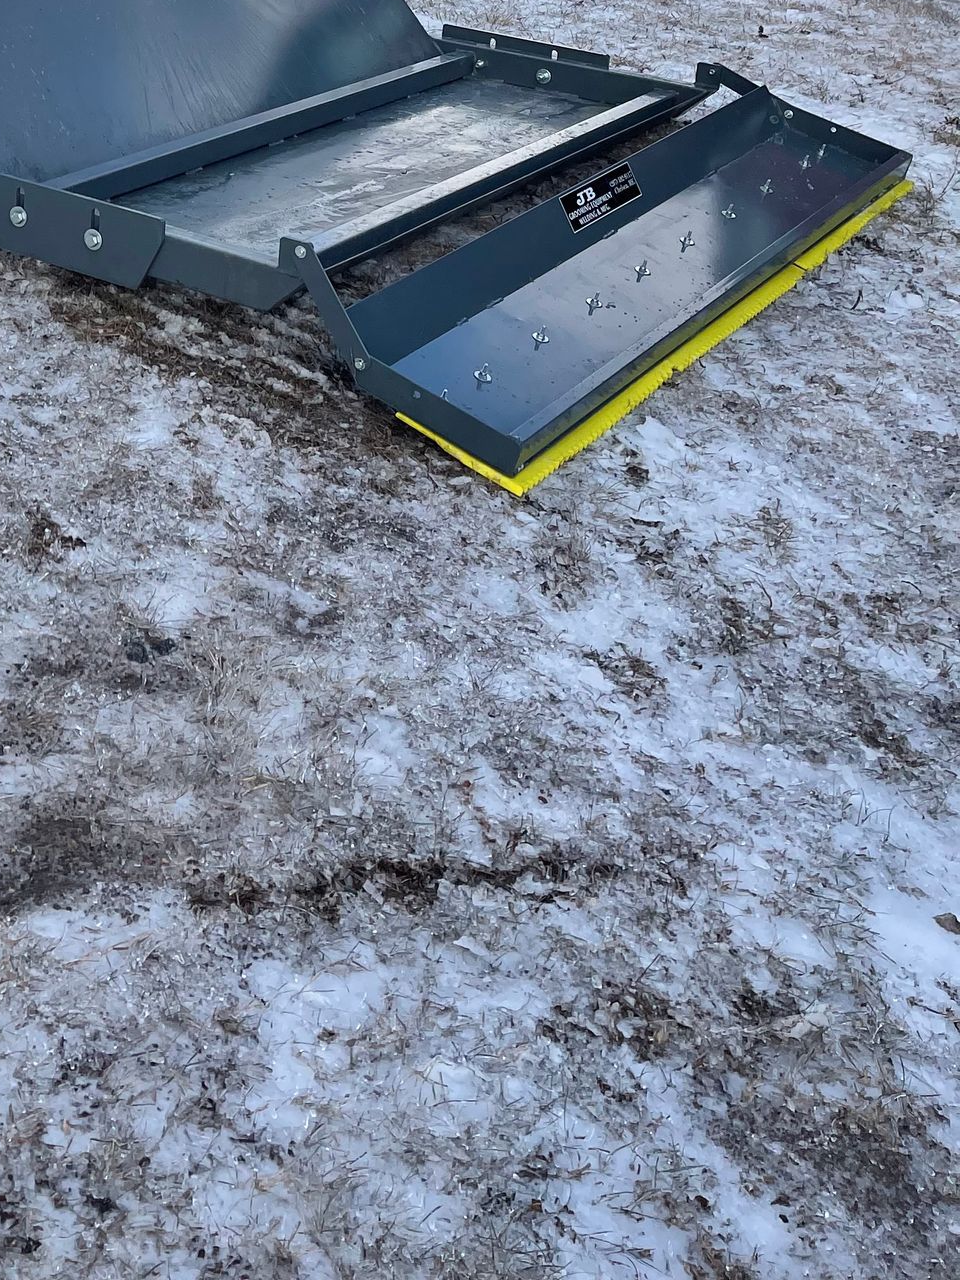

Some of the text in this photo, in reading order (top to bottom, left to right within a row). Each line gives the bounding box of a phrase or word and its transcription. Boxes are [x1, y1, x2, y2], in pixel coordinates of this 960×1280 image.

[568, 191, 613, 221] GROOMING EQUIPMENT
[576, 186, 596, 206] JB
